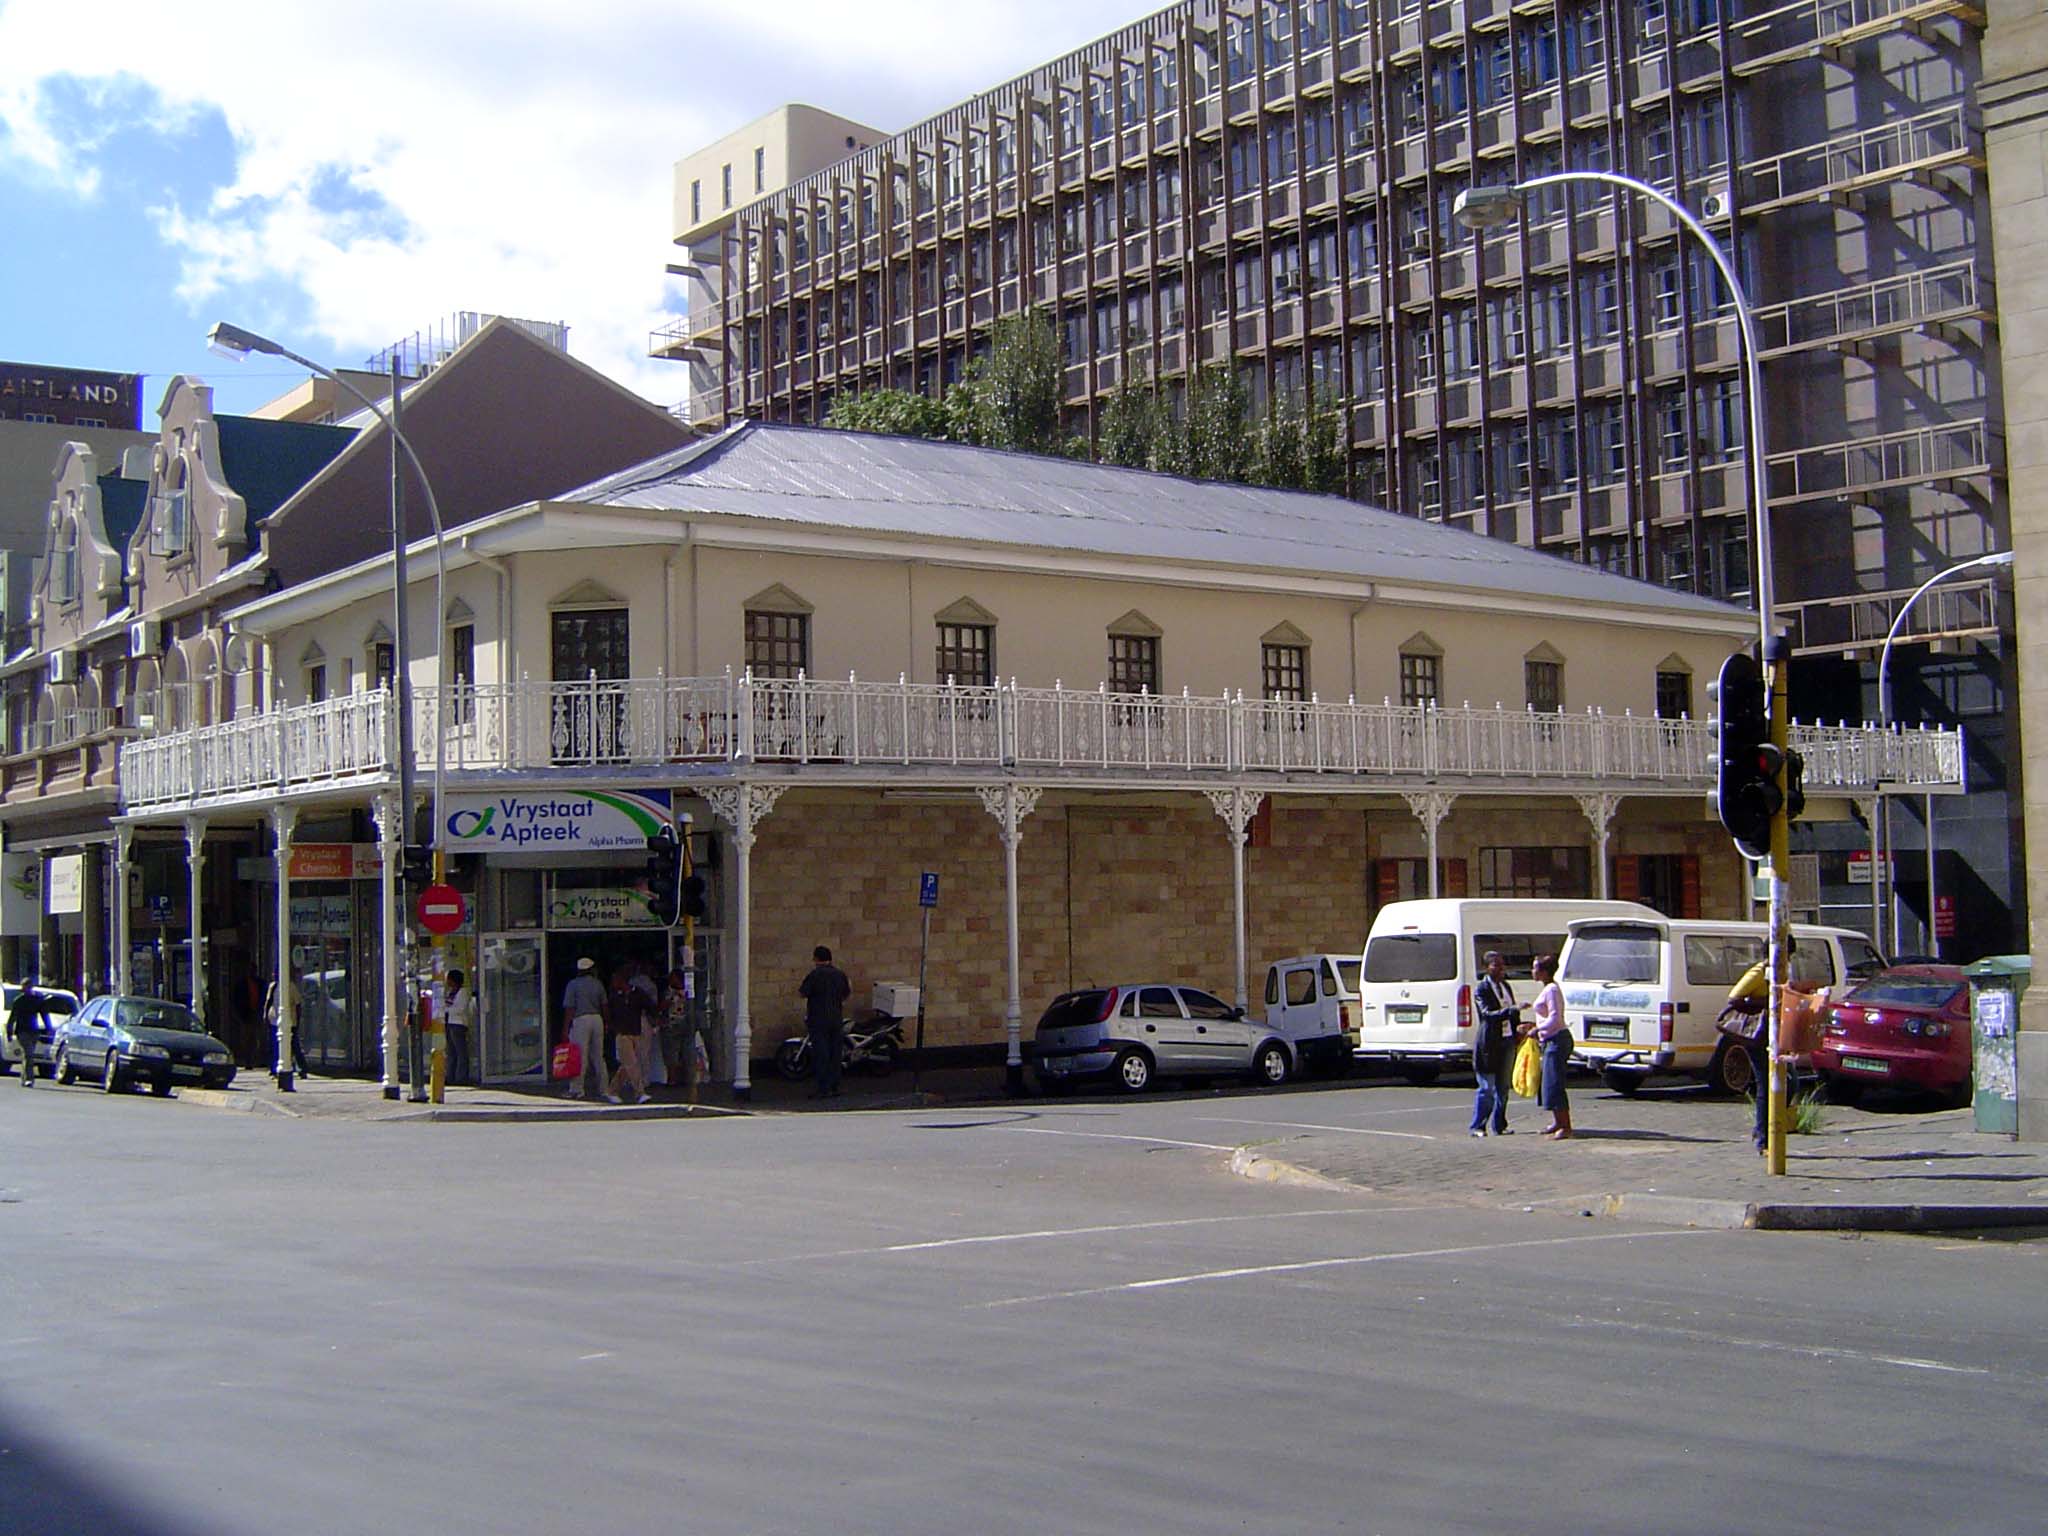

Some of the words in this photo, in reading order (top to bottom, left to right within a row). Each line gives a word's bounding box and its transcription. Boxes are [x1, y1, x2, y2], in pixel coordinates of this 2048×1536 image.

[500, 798, 593, 823] Vrystaat
[500, 820, 581, 845] Apteek
[588, 836, 614, 848] Alpha
[300, 847, 342, 861] Vrystaat
[300, 863, 343, 874] Chemist
[927, 875, 935, 887] P
[160, 896, 169, 908] P
[578, 896, 629, 909] Vrystaat
[579, 908, 622, 922] Apteek
